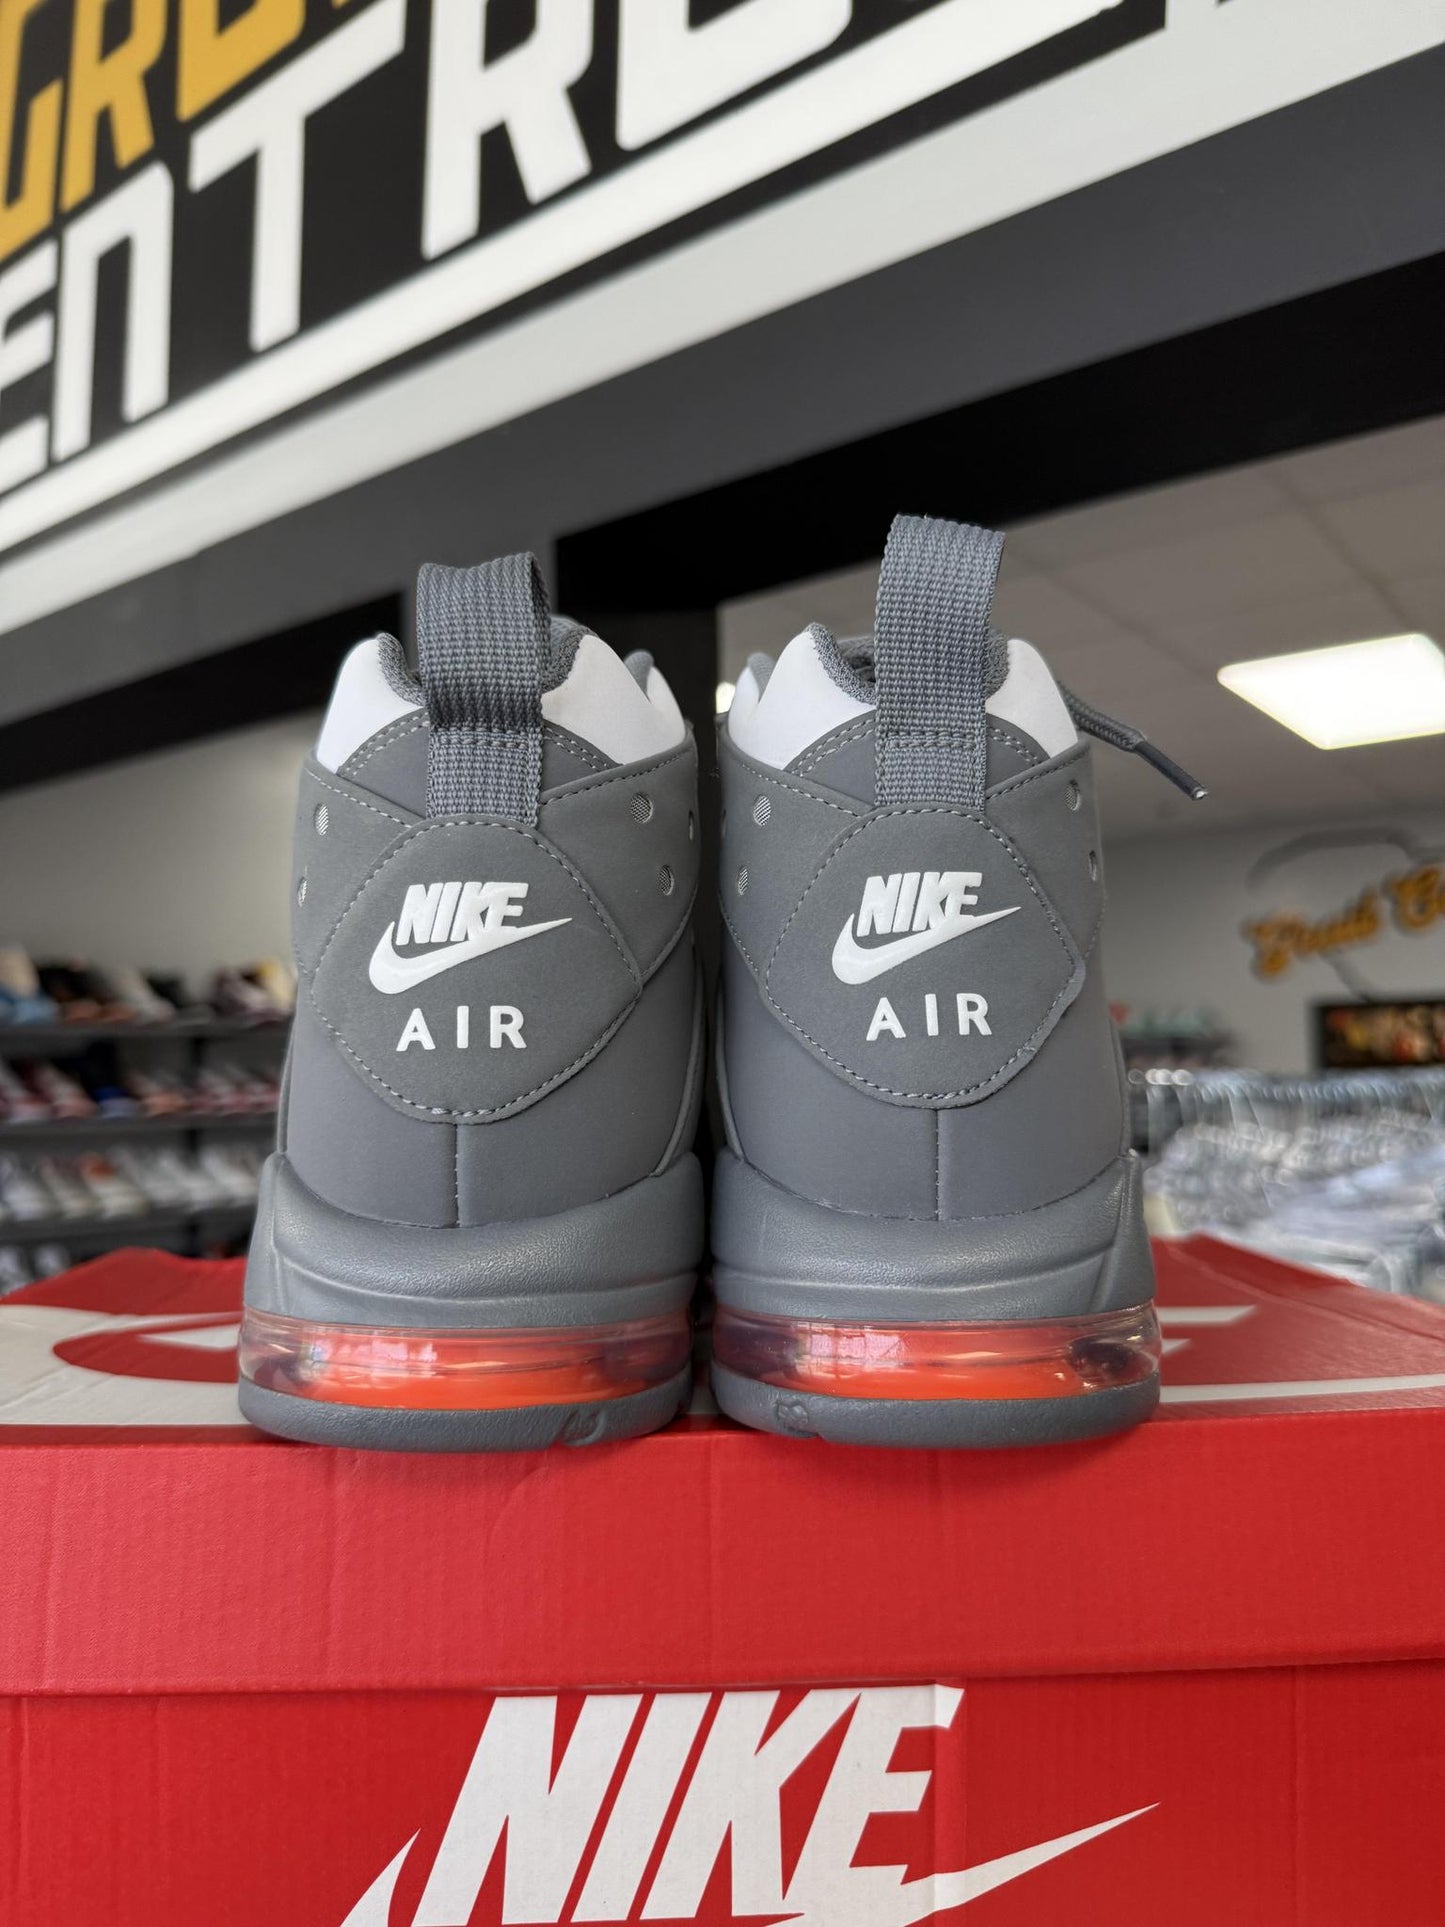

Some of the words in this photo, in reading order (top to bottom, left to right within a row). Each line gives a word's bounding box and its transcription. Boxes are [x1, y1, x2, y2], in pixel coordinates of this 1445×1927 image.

[396, 881, 529, 945] NIKE
[857, 872, 983, 937] NIKE
[396, 1005, 527, 1052] AIR
[866, 993, 992, 1041] AIR
[411, 1683, 965, 1927] NIKE
